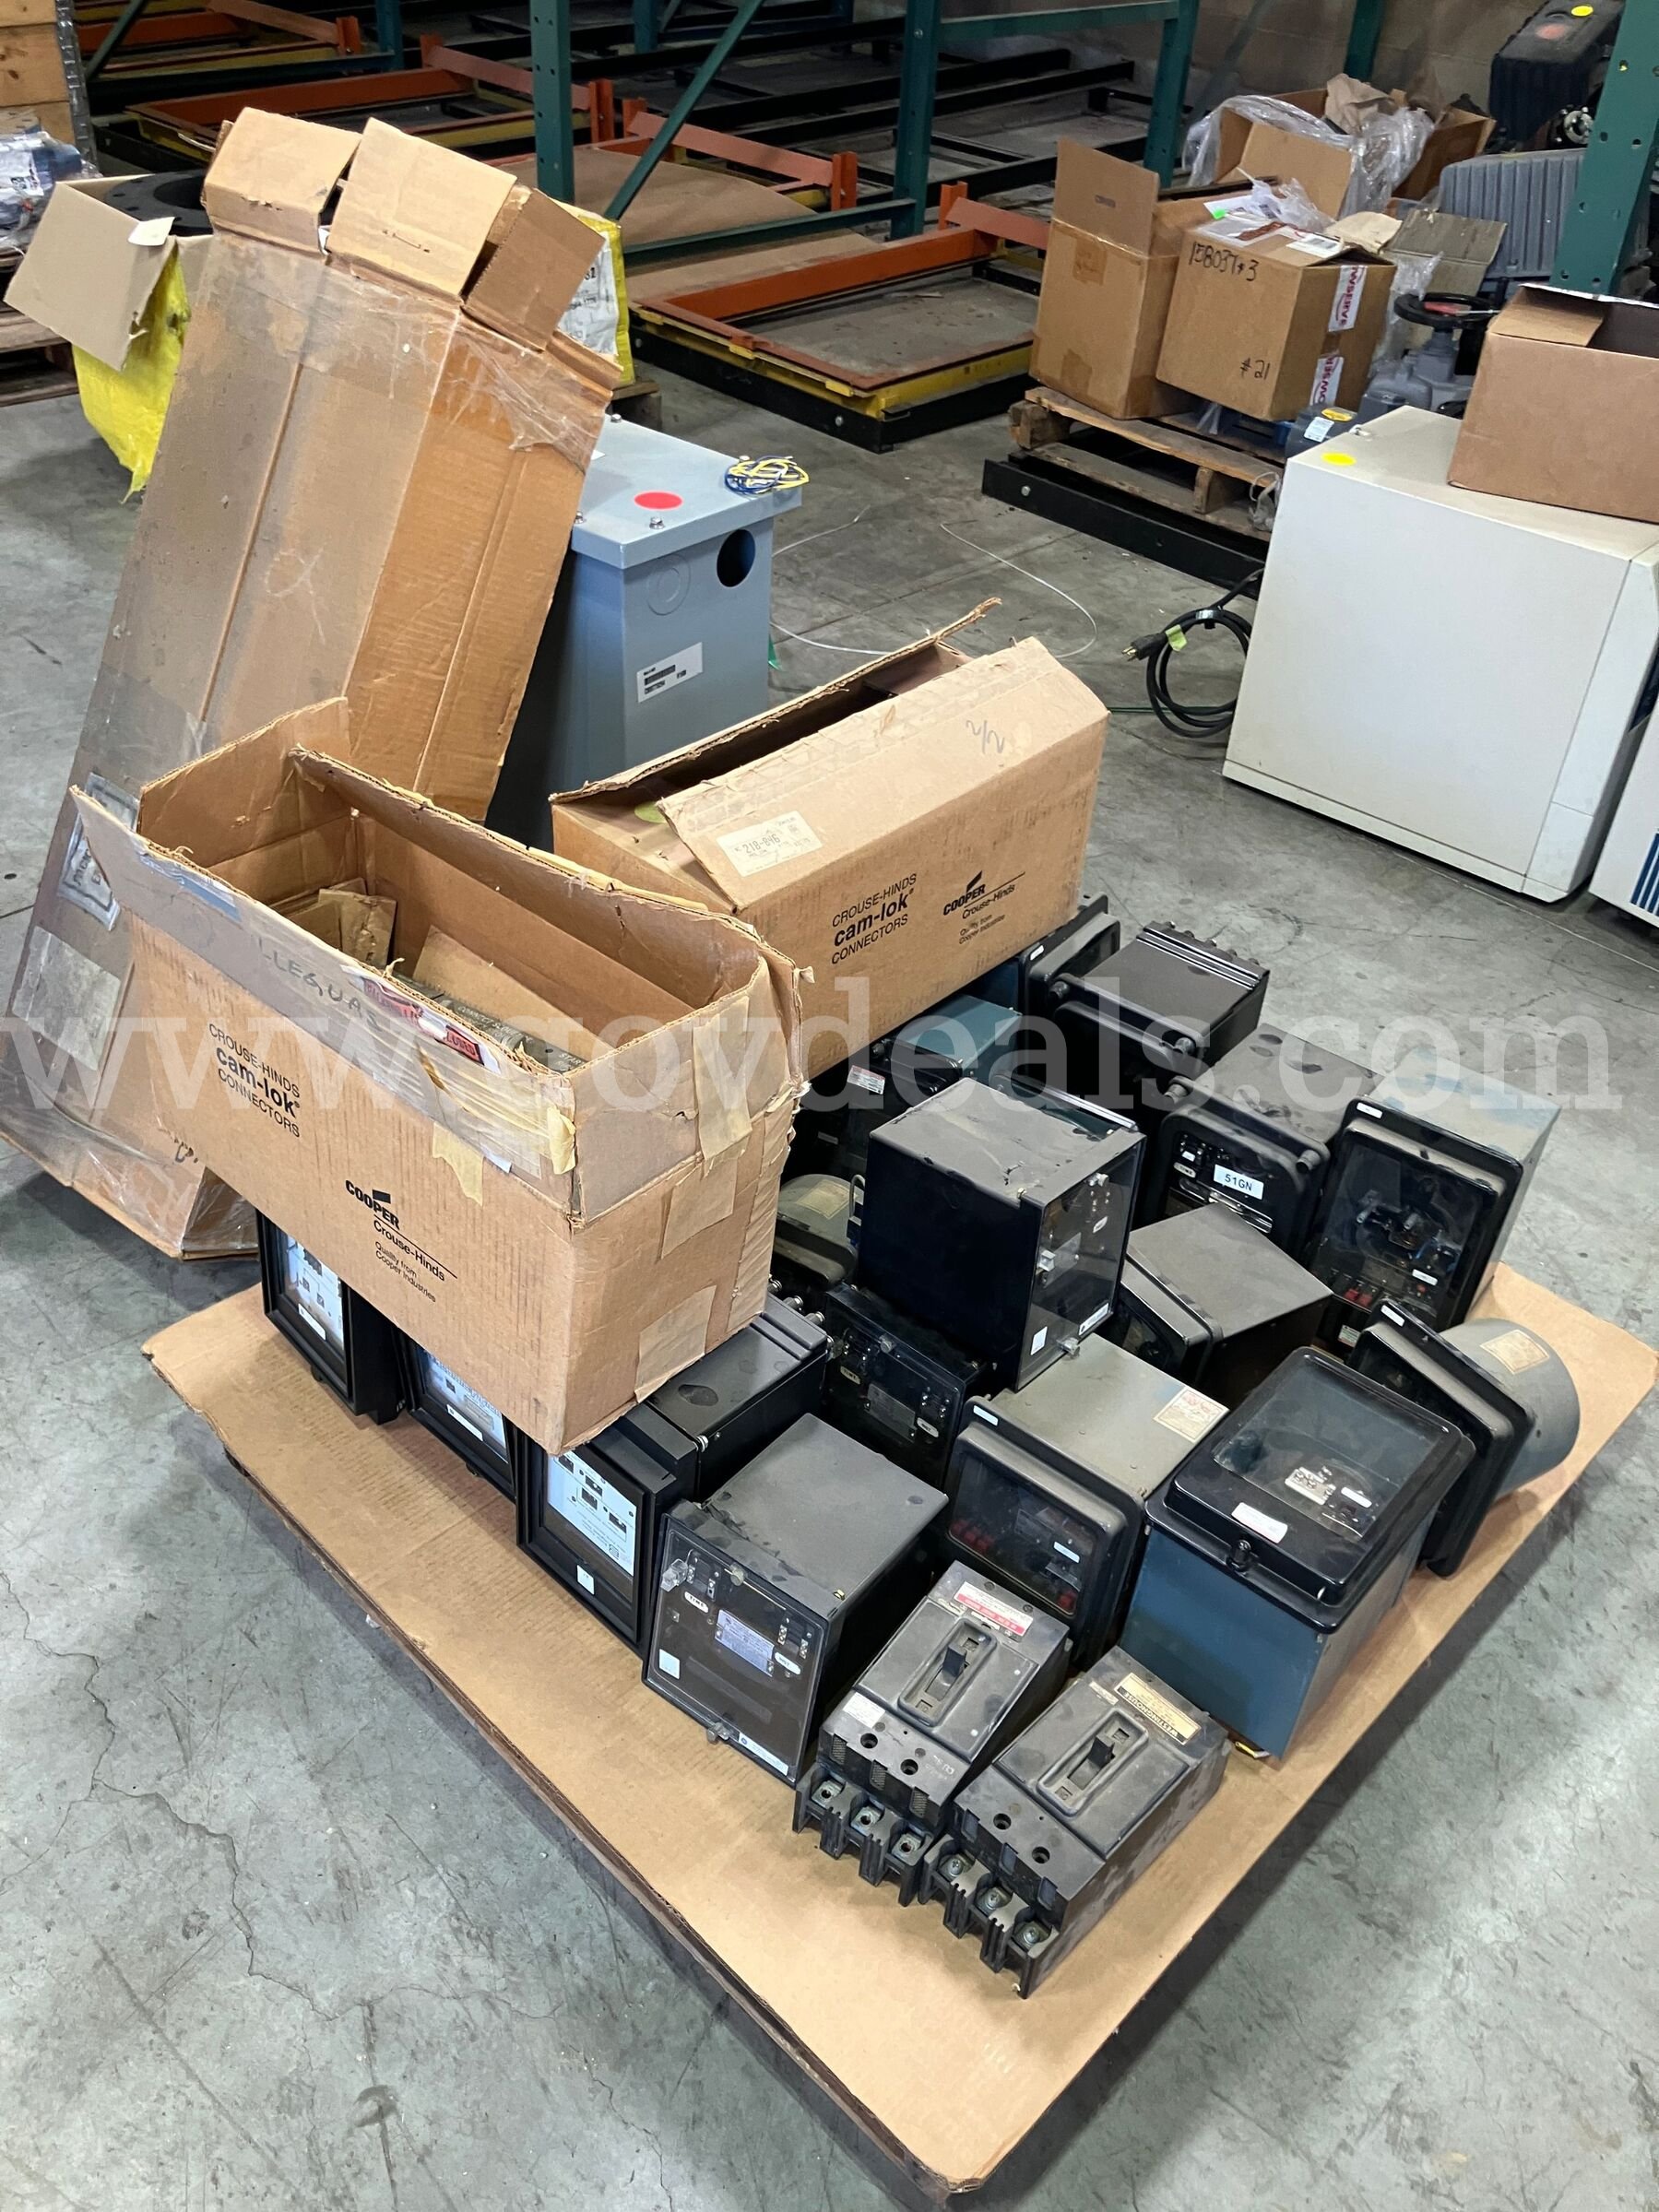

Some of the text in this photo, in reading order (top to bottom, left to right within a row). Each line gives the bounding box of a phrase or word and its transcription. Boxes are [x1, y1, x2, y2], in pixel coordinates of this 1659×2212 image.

[832, 873, 917, 927] CROUSE-HINDS
[943, 884, 986, 916] COOPER
[962, 884, 1015, 919] Crouse-Hinds
[832, 914, 908, 964] CONNECTORS
[209, 1023, 300, 1098] CROUSE-HINDS
[218, 1069, 300, 1138] CONNECTORS
[346, 1180, 400, 1231] COOPER
[1224, 1174, 1252, 1191] 51GN
[373, 1220, 444, 1282] Crouse-Hinds
[375, 1241, 418, 1279] Quality from
[376, 1250, 436, 1303] Cooper Industries
[1125, 1691, 1179, 1737] WESTINGHOUSE
